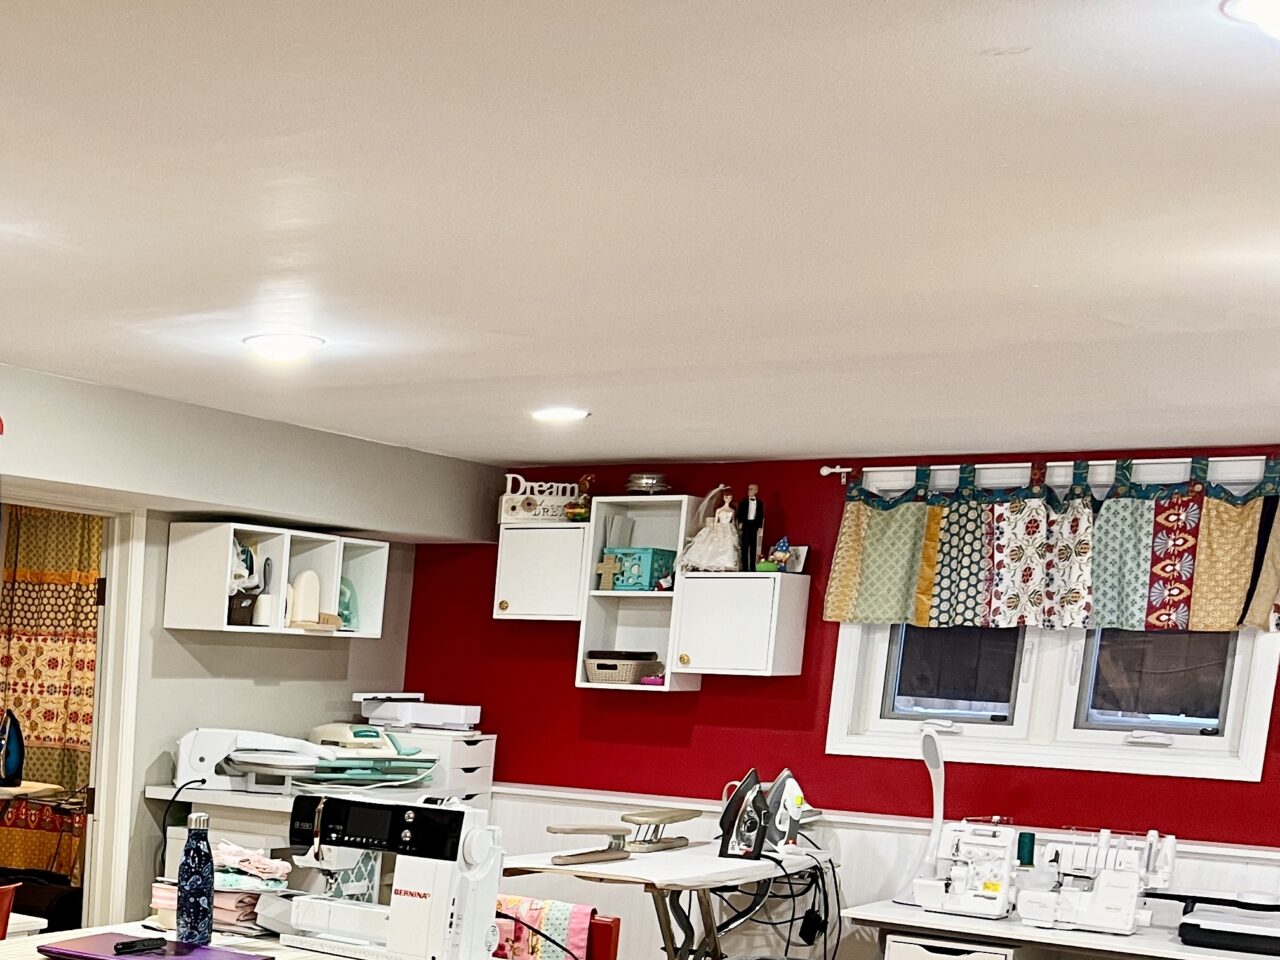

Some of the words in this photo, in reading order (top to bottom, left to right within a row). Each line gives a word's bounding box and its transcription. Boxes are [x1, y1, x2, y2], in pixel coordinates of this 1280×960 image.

[505, 473, 579, 497] Dream
[532, 504, 567, 518] DREA
[394, 888, 428, 900] BERNINA
